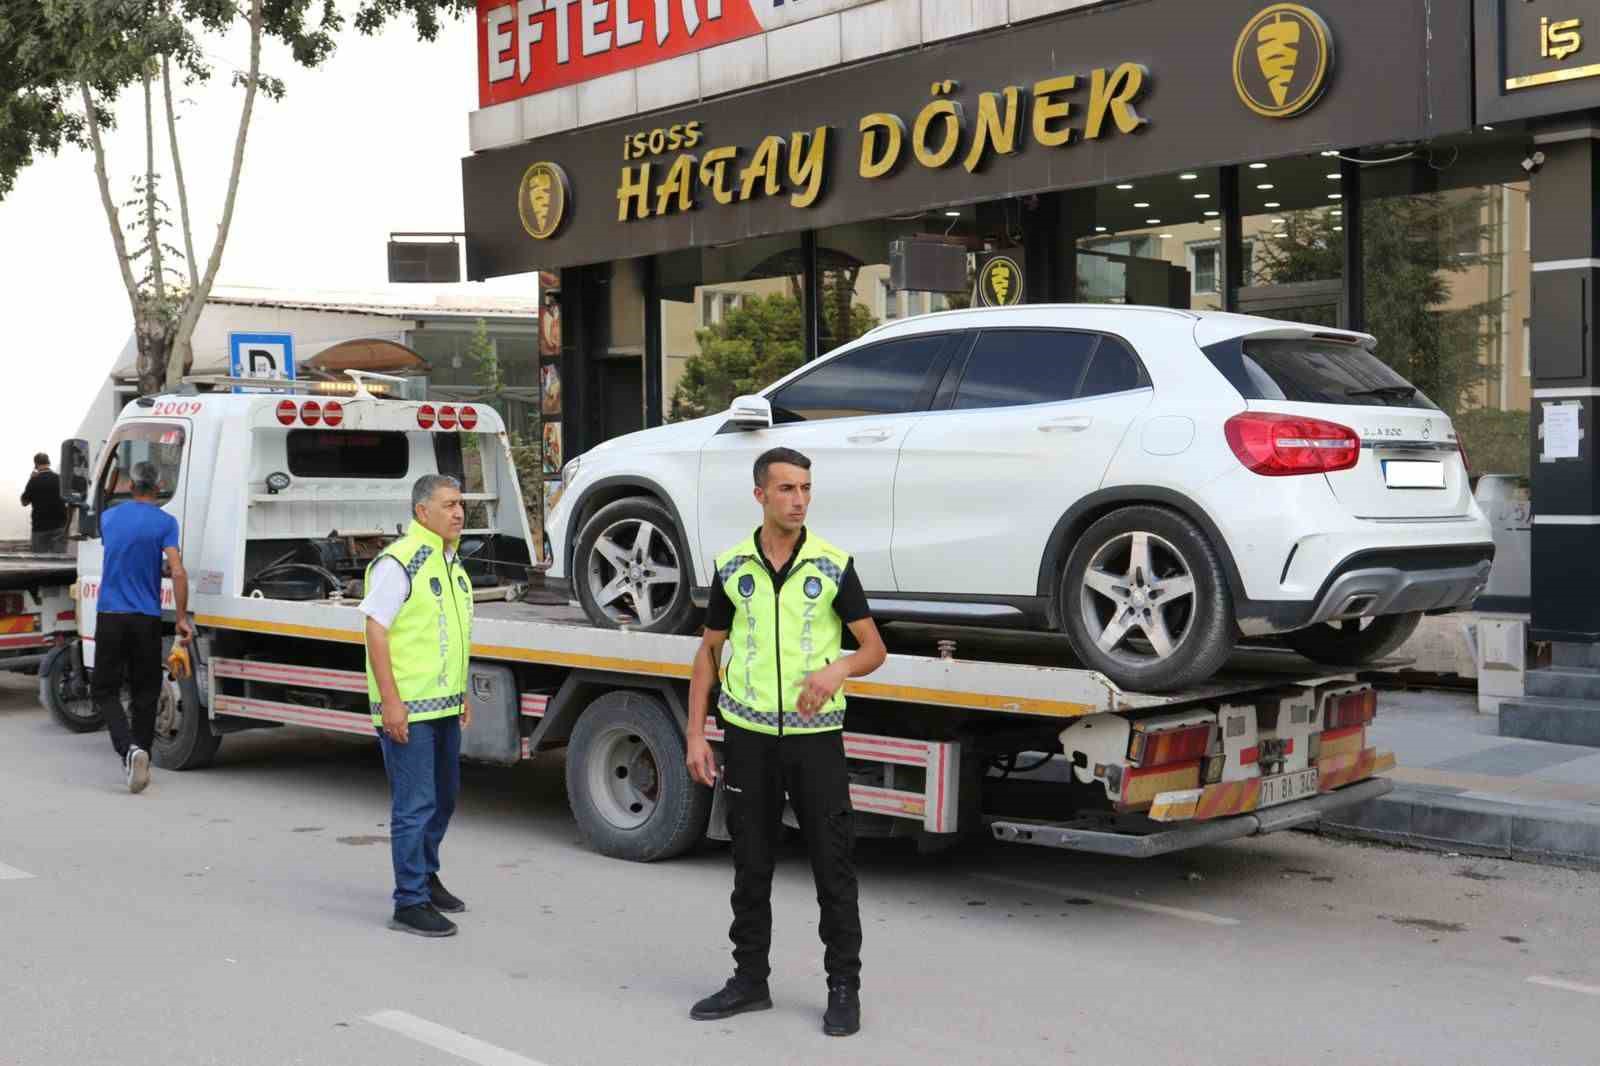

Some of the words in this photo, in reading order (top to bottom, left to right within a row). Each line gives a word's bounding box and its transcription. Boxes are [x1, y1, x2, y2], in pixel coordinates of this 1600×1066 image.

[616, 125, 830, 221] HATAY
[858, 62, 1149, 179] DÖNER
[153, 401, 202, 416] 2009
